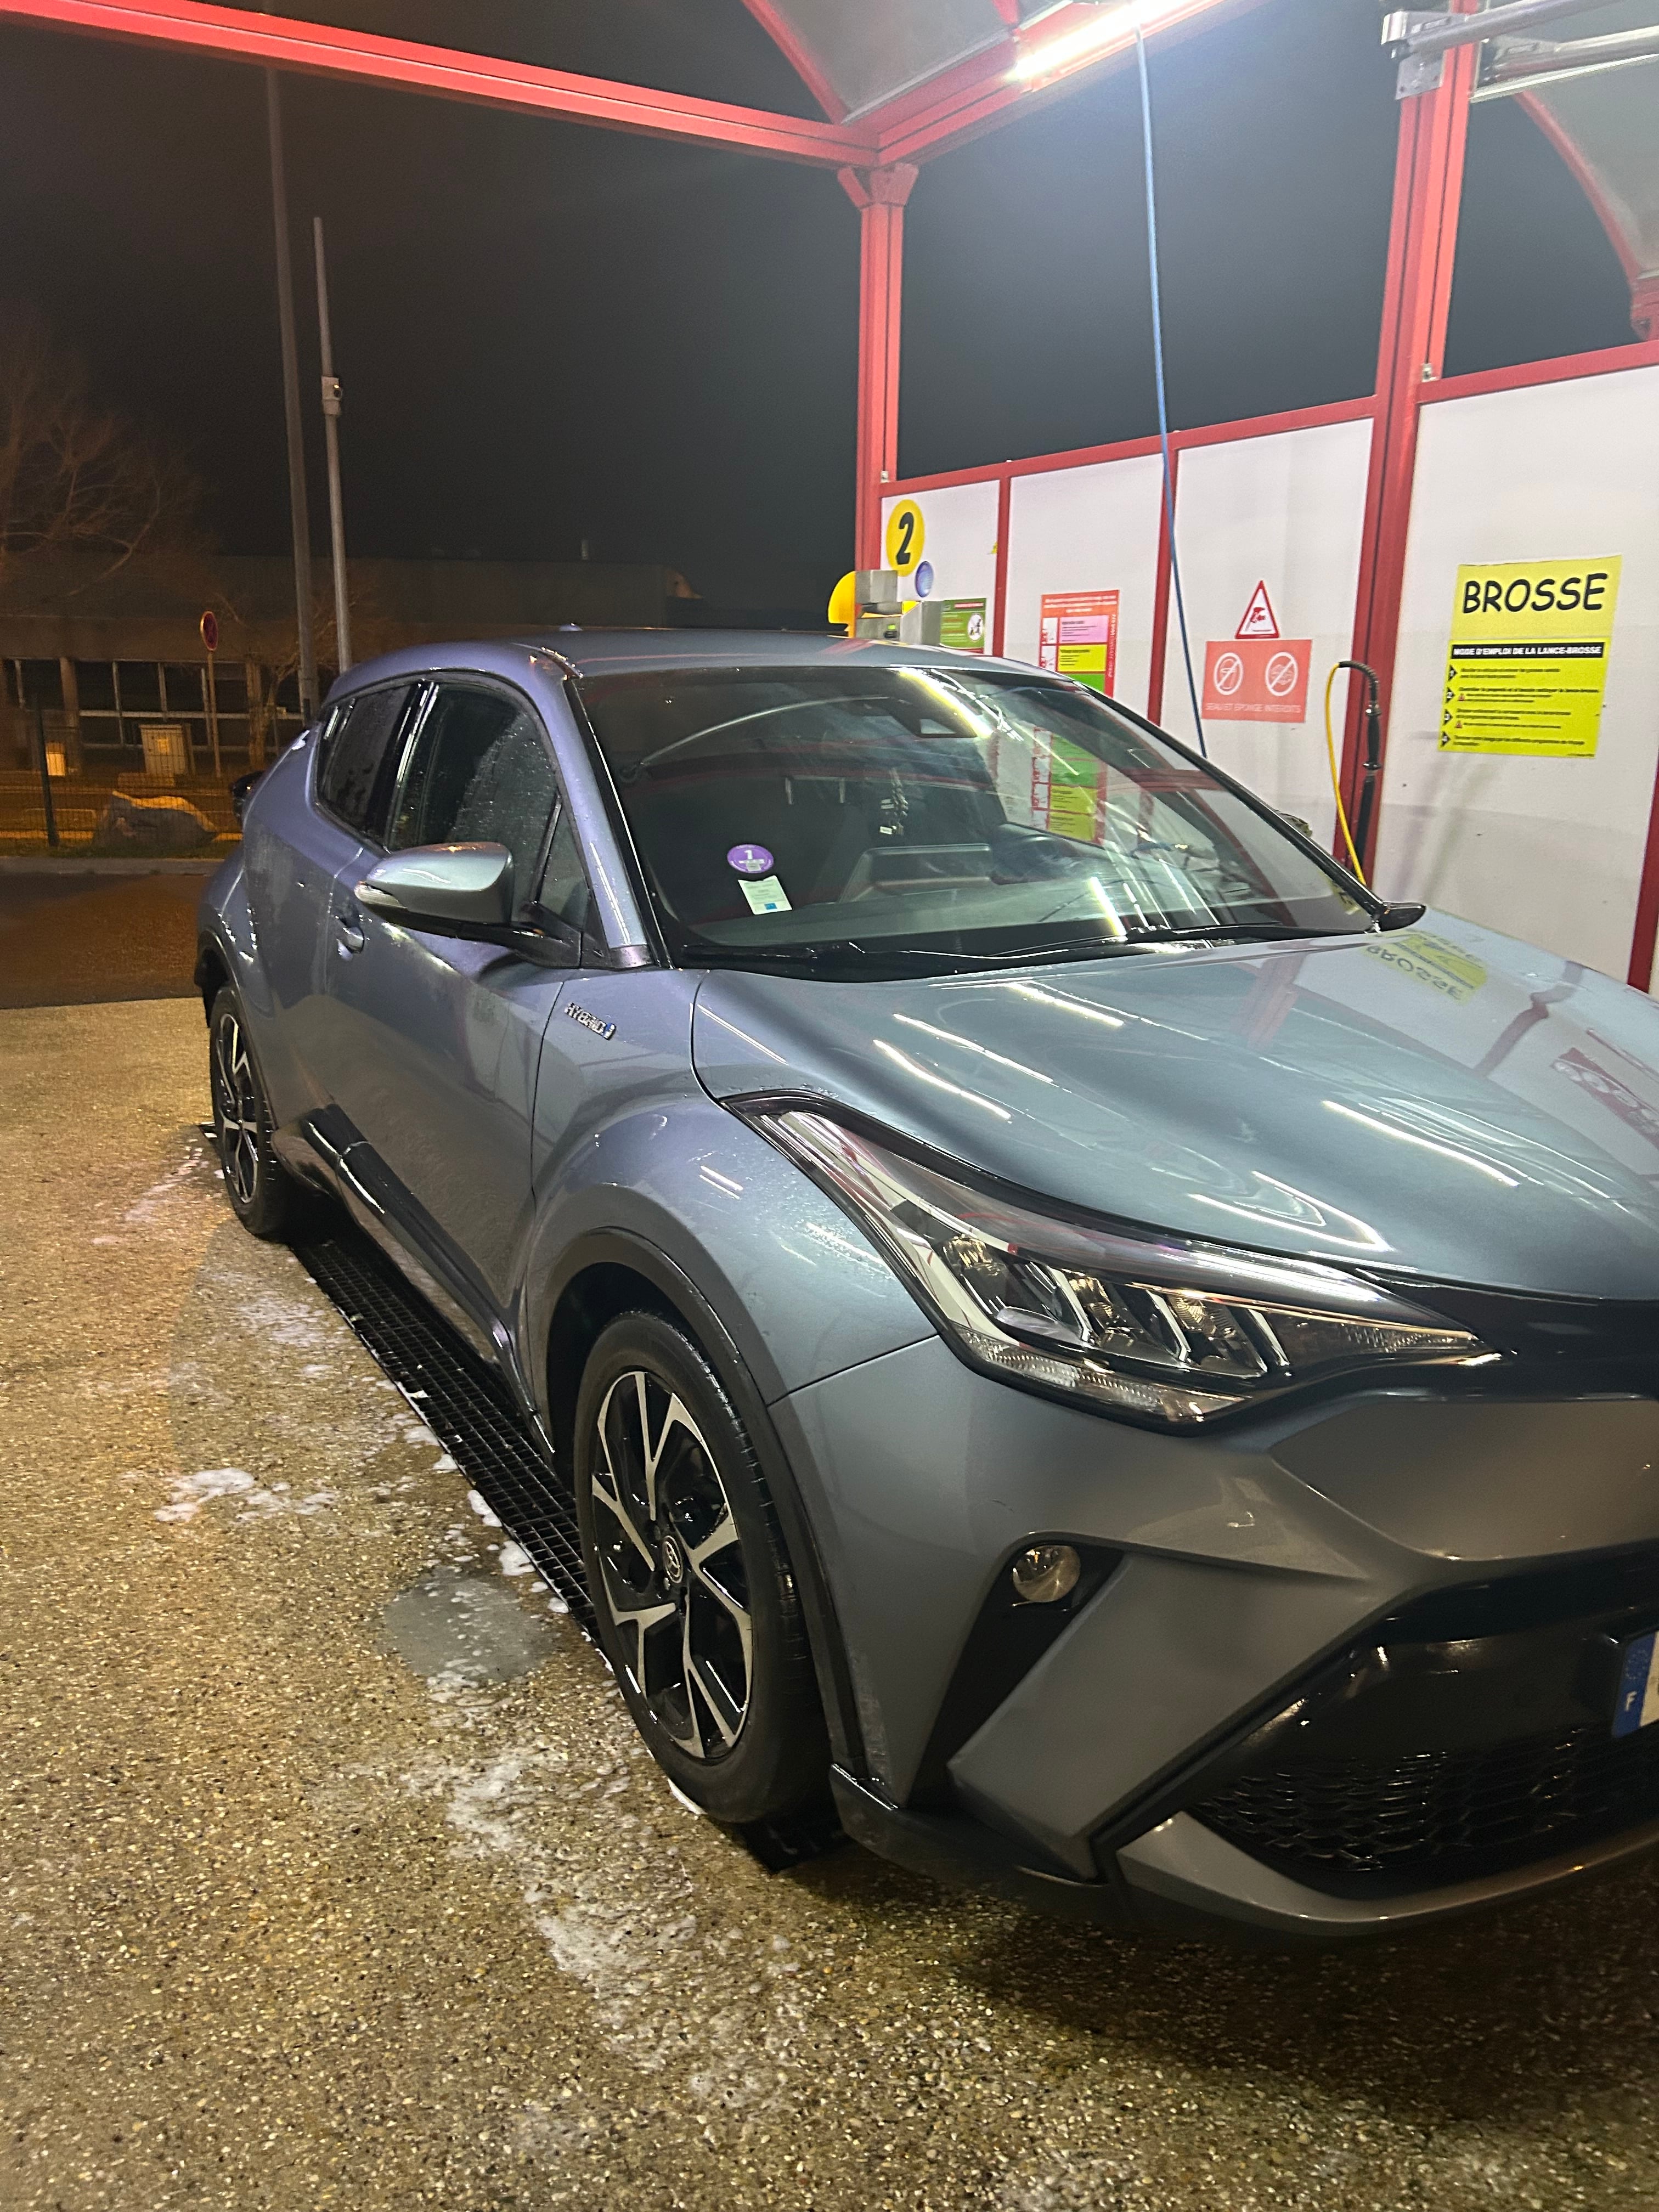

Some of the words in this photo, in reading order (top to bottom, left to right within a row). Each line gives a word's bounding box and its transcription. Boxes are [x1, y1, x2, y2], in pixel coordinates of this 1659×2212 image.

[896, 512, 914, 565] 2
[1463, 573, 1608, 613] BROSSE
[1537, 646, 1602, 654] LANCE-BROSSE
[744, 850, 753, 860] 1
[564, 1002, 606, 1035] HYBRID
[1626, 1690, 1638, 1712] F
